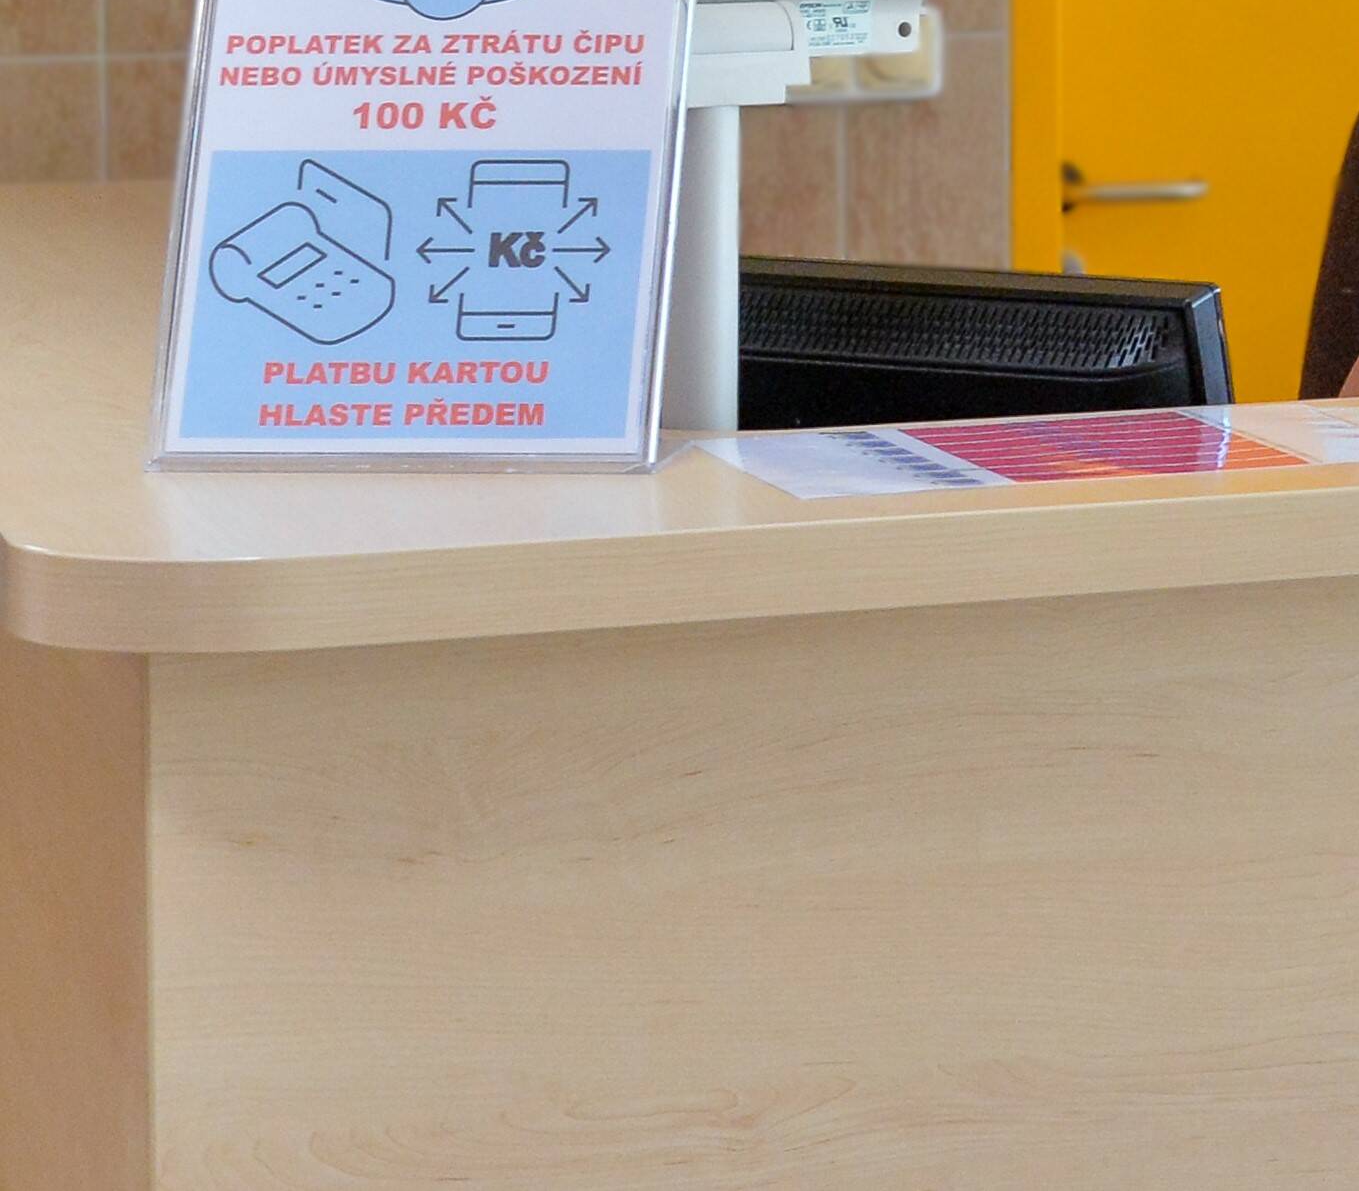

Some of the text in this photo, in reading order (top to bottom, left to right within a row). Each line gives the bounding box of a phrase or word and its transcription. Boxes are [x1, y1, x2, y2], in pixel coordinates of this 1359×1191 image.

[226, 29, 645, 55] POPLATEK ZA ZTRÁTU ČIPU
[219, 61, 643, 86] NEBO ÚMYSLNÉ POŠKOZENÍ
[353, 96, 497, 130] 100 KČ
[488, 231, 546, 268] Kč
[263, 361, 550, 385] PLATBU KARTOU
[258, 397, 545, 427] HLASTE PŘEDEM
